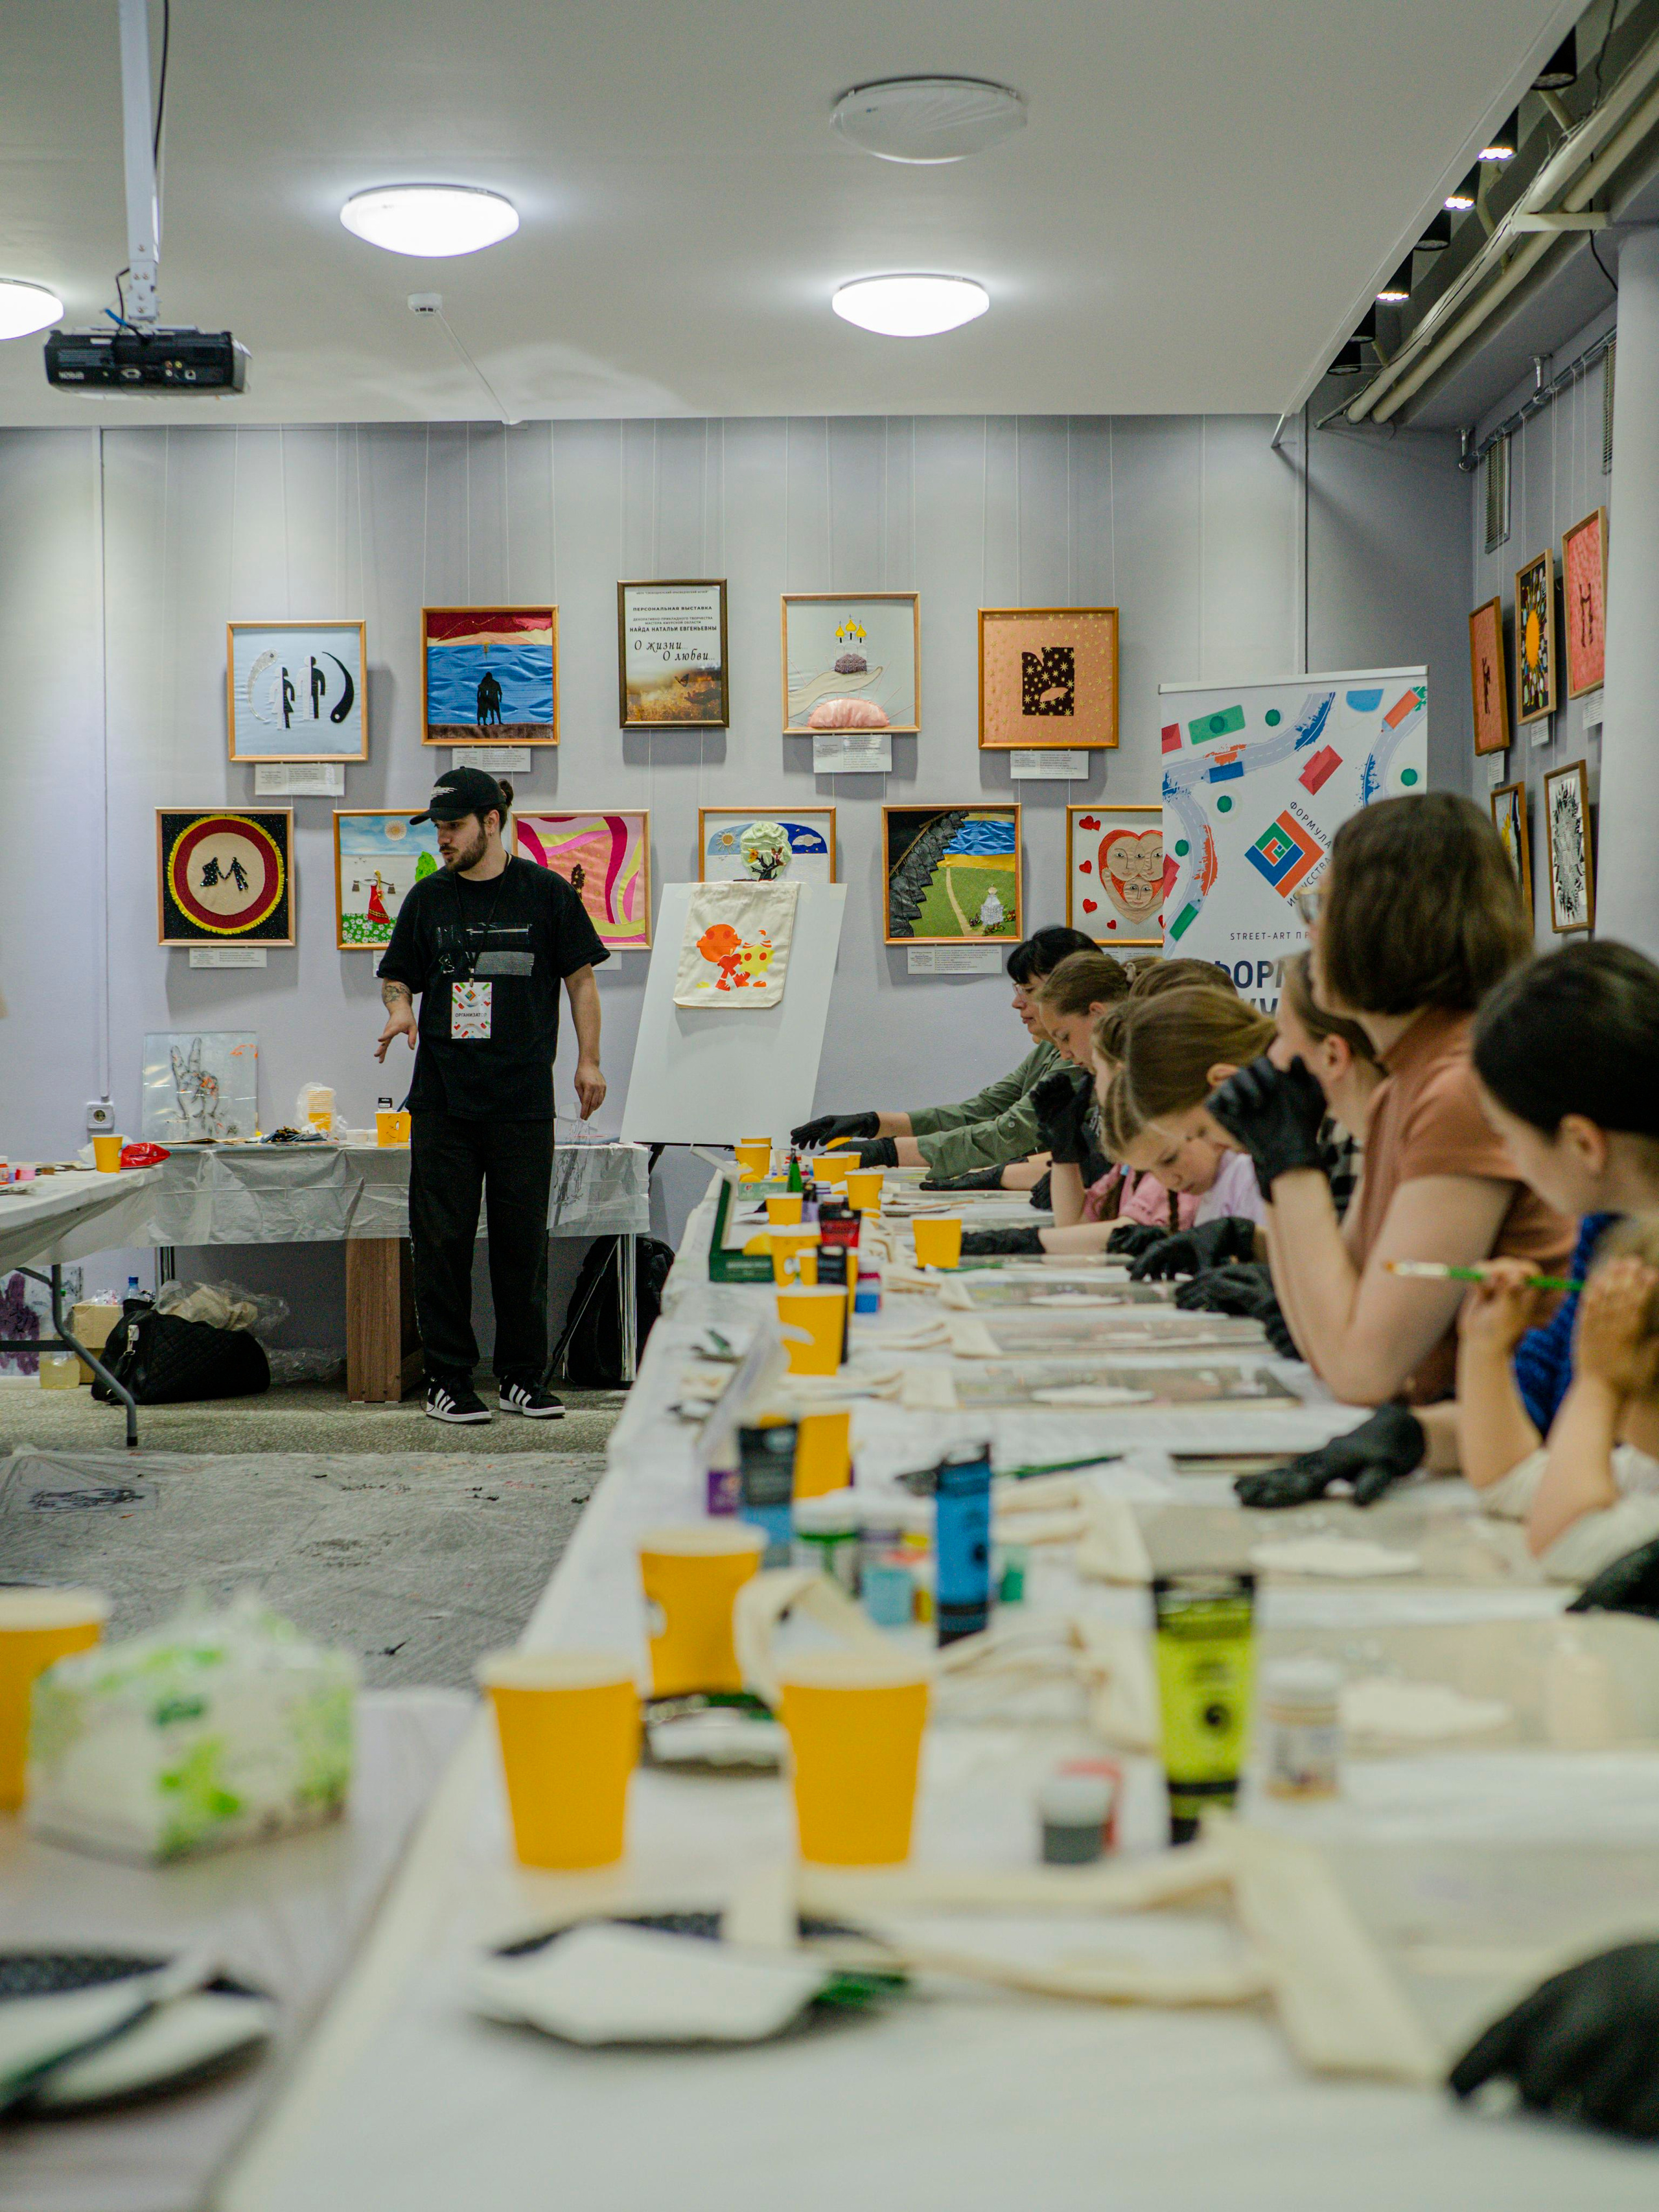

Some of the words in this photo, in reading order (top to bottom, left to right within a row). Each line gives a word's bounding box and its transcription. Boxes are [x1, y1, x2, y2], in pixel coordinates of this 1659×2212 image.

[634, 640, 642, 651] О
[663, 650, 671, 661] О
[1290, 801, 1332, 849] ФОРМУЛА
[1230, 932, 1291, 940] STREET-ART
